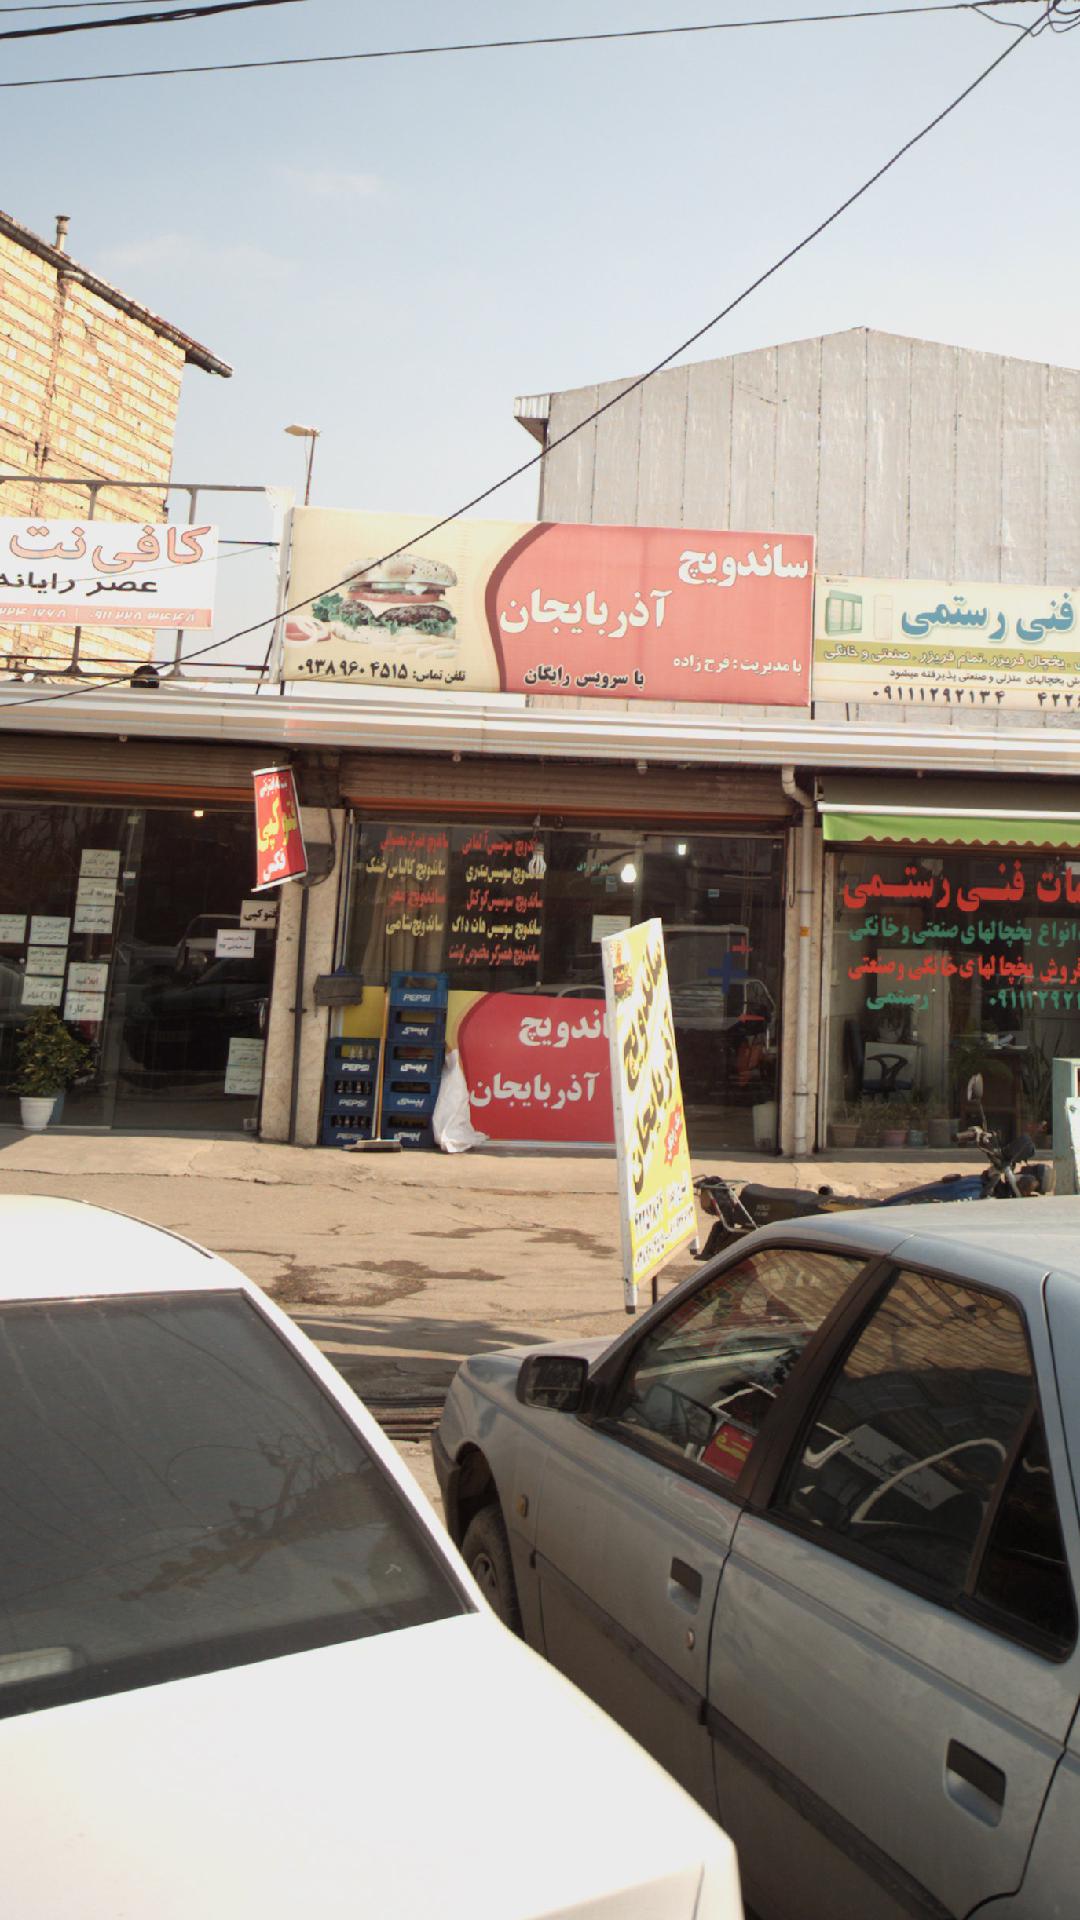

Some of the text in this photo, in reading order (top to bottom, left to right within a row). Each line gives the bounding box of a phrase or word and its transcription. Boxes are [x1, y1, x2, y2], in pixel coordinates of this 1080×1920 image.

[9, 525, 211, 574] کافی نت
[678, 543, 808, 587] ساندویچ
[86, 579, 158, 596] عصر
[499, 588, 673, 638] آذربایجان
[901, 592, 1075, 642] فنی رستمی
[823, 643, 859, 660] خانگی
[861, 649, 870, 661] و
[871, 647, 911, 662] صنعتی
[297, 658, 336, 676] ۰۹۳۸
[339, 660, 365, 676] ۹۶۰
[370, 661, 408, 680] ۴۵۱۵
[673, 654, 702, 673] زاده
[704, 655, 731, 673] فرح
[791, 661, 802, 675] با
[1027, 654, 1065, 671] یخچال
[444, 669, 467, 684] تلفن
[523, 664, 645, 689] با سرویس رایگان
[872, 685, 1080, 708] ۰۹۱۱۱۲۹۲۱۳۴ ۴۲۲
[843, 865, 951, 909] رستمی
[956, 858, 1025, 912] فنی
[850, 914, 899, 942] خانگی
[900, 926, 911, 945] و
[911, 920, 959, 945] صنعتی
[403, 994, 431, 1002] PEPSI
[866, 988, 929, 1010] رستمی
[518, 1008, 609, 1049] اندویچ
[341, 1063, 370, 1072] PEPSI
[470, 1072, 601, 1110] آذربایجان
[338, 1098, 368, 1108] PEPSI
